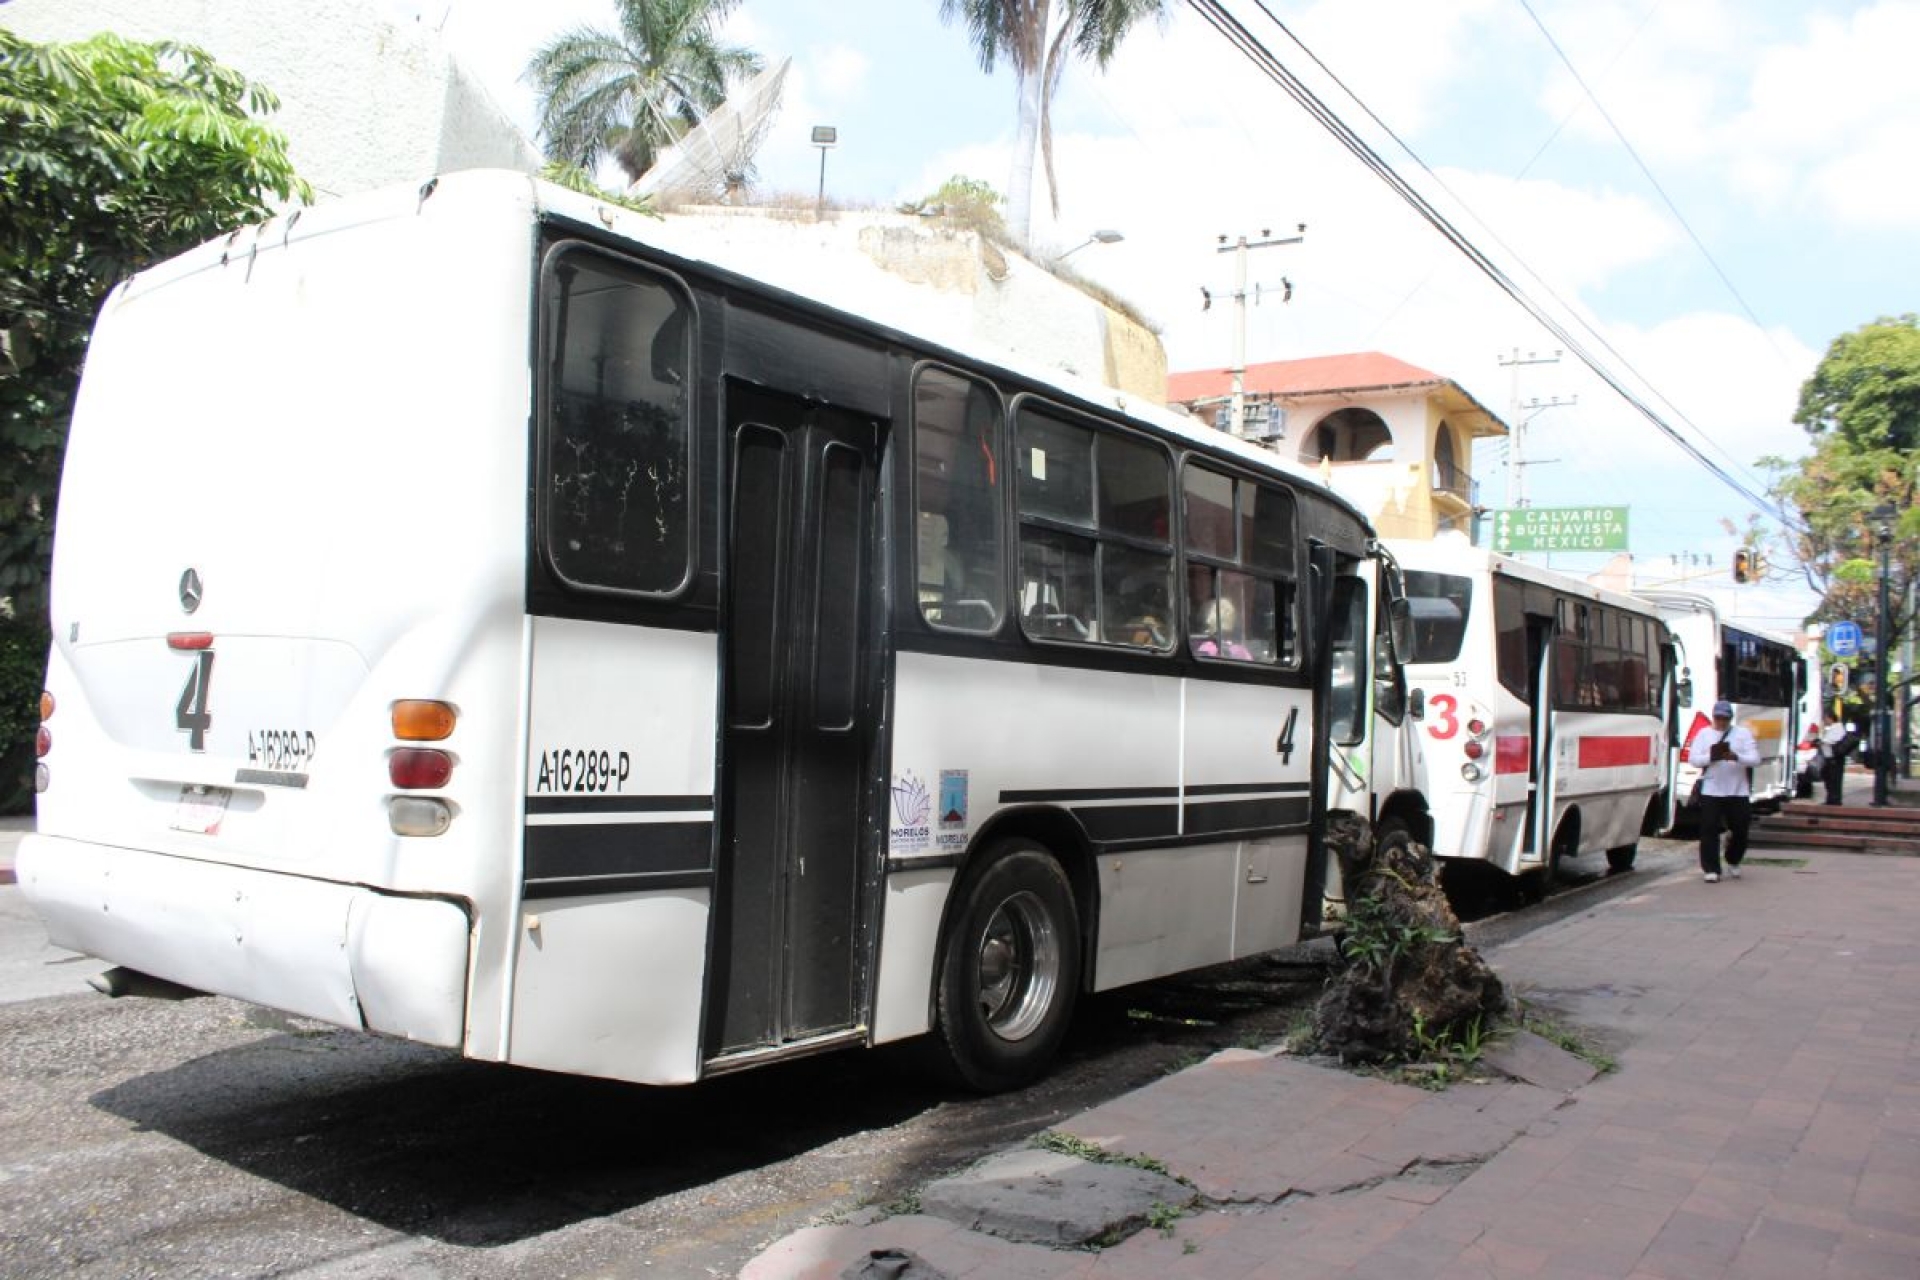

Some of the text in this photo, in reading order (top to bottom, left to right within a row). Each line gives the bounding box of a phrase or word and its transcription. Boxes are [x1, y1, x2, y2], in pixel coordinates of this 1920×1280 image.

[1525, 509, 1614, 523] CALVARIO
[1514, 522, 1622, 536] BUENAVISTA
[1534, 535, 1604, 548] MEXICO
[176, 650, 215, 753] 4
[1427, 693, 1459, 740] 3
[1276, 707, 1298, 766] 4
[890, 827, 930, 838] MORELOS
